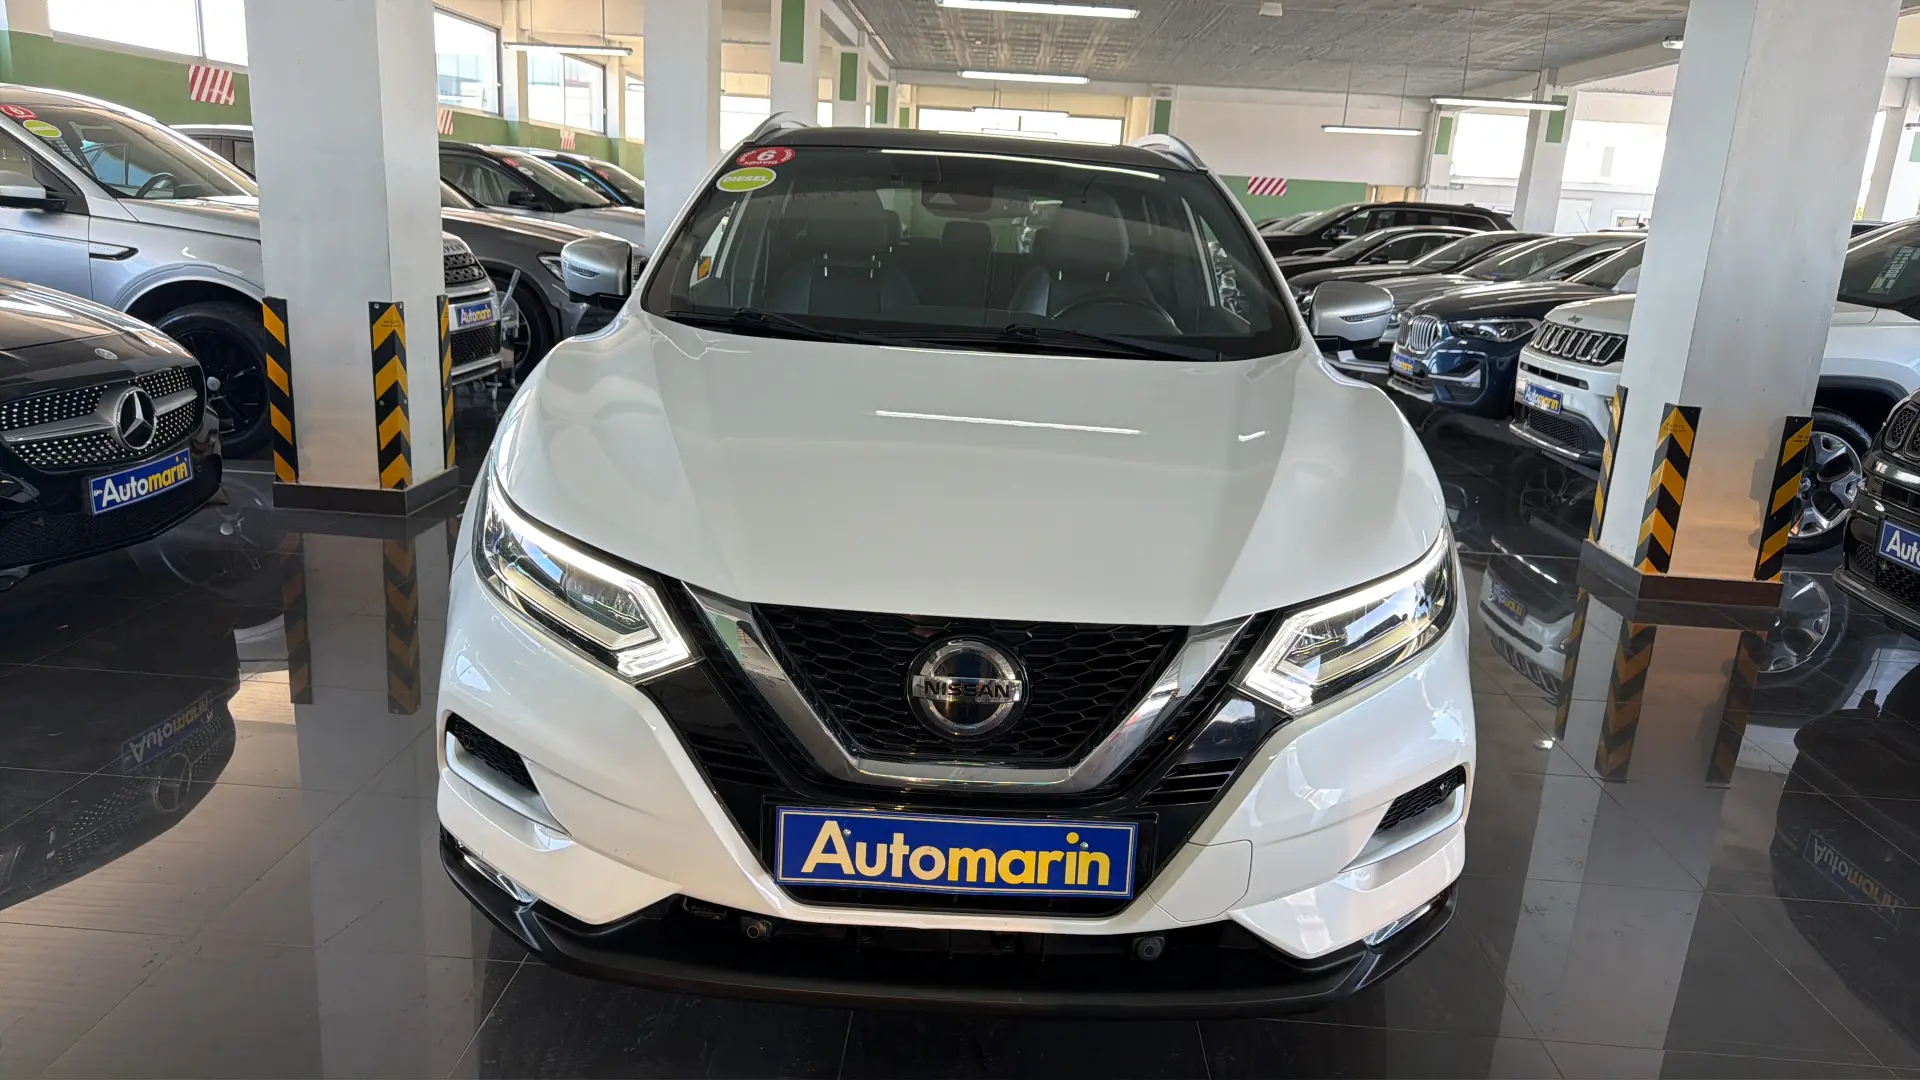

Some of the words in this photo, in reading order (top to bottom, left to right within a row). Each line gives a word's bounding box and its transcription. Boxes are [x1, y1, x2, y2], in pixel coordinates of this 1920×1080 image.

[757, 150, 777, 160] 6
[102, 456, 188, 507] Automarin
[924, 681, 1009, 698] NISSAN
[801, 820, 1110, 886] Automarin
